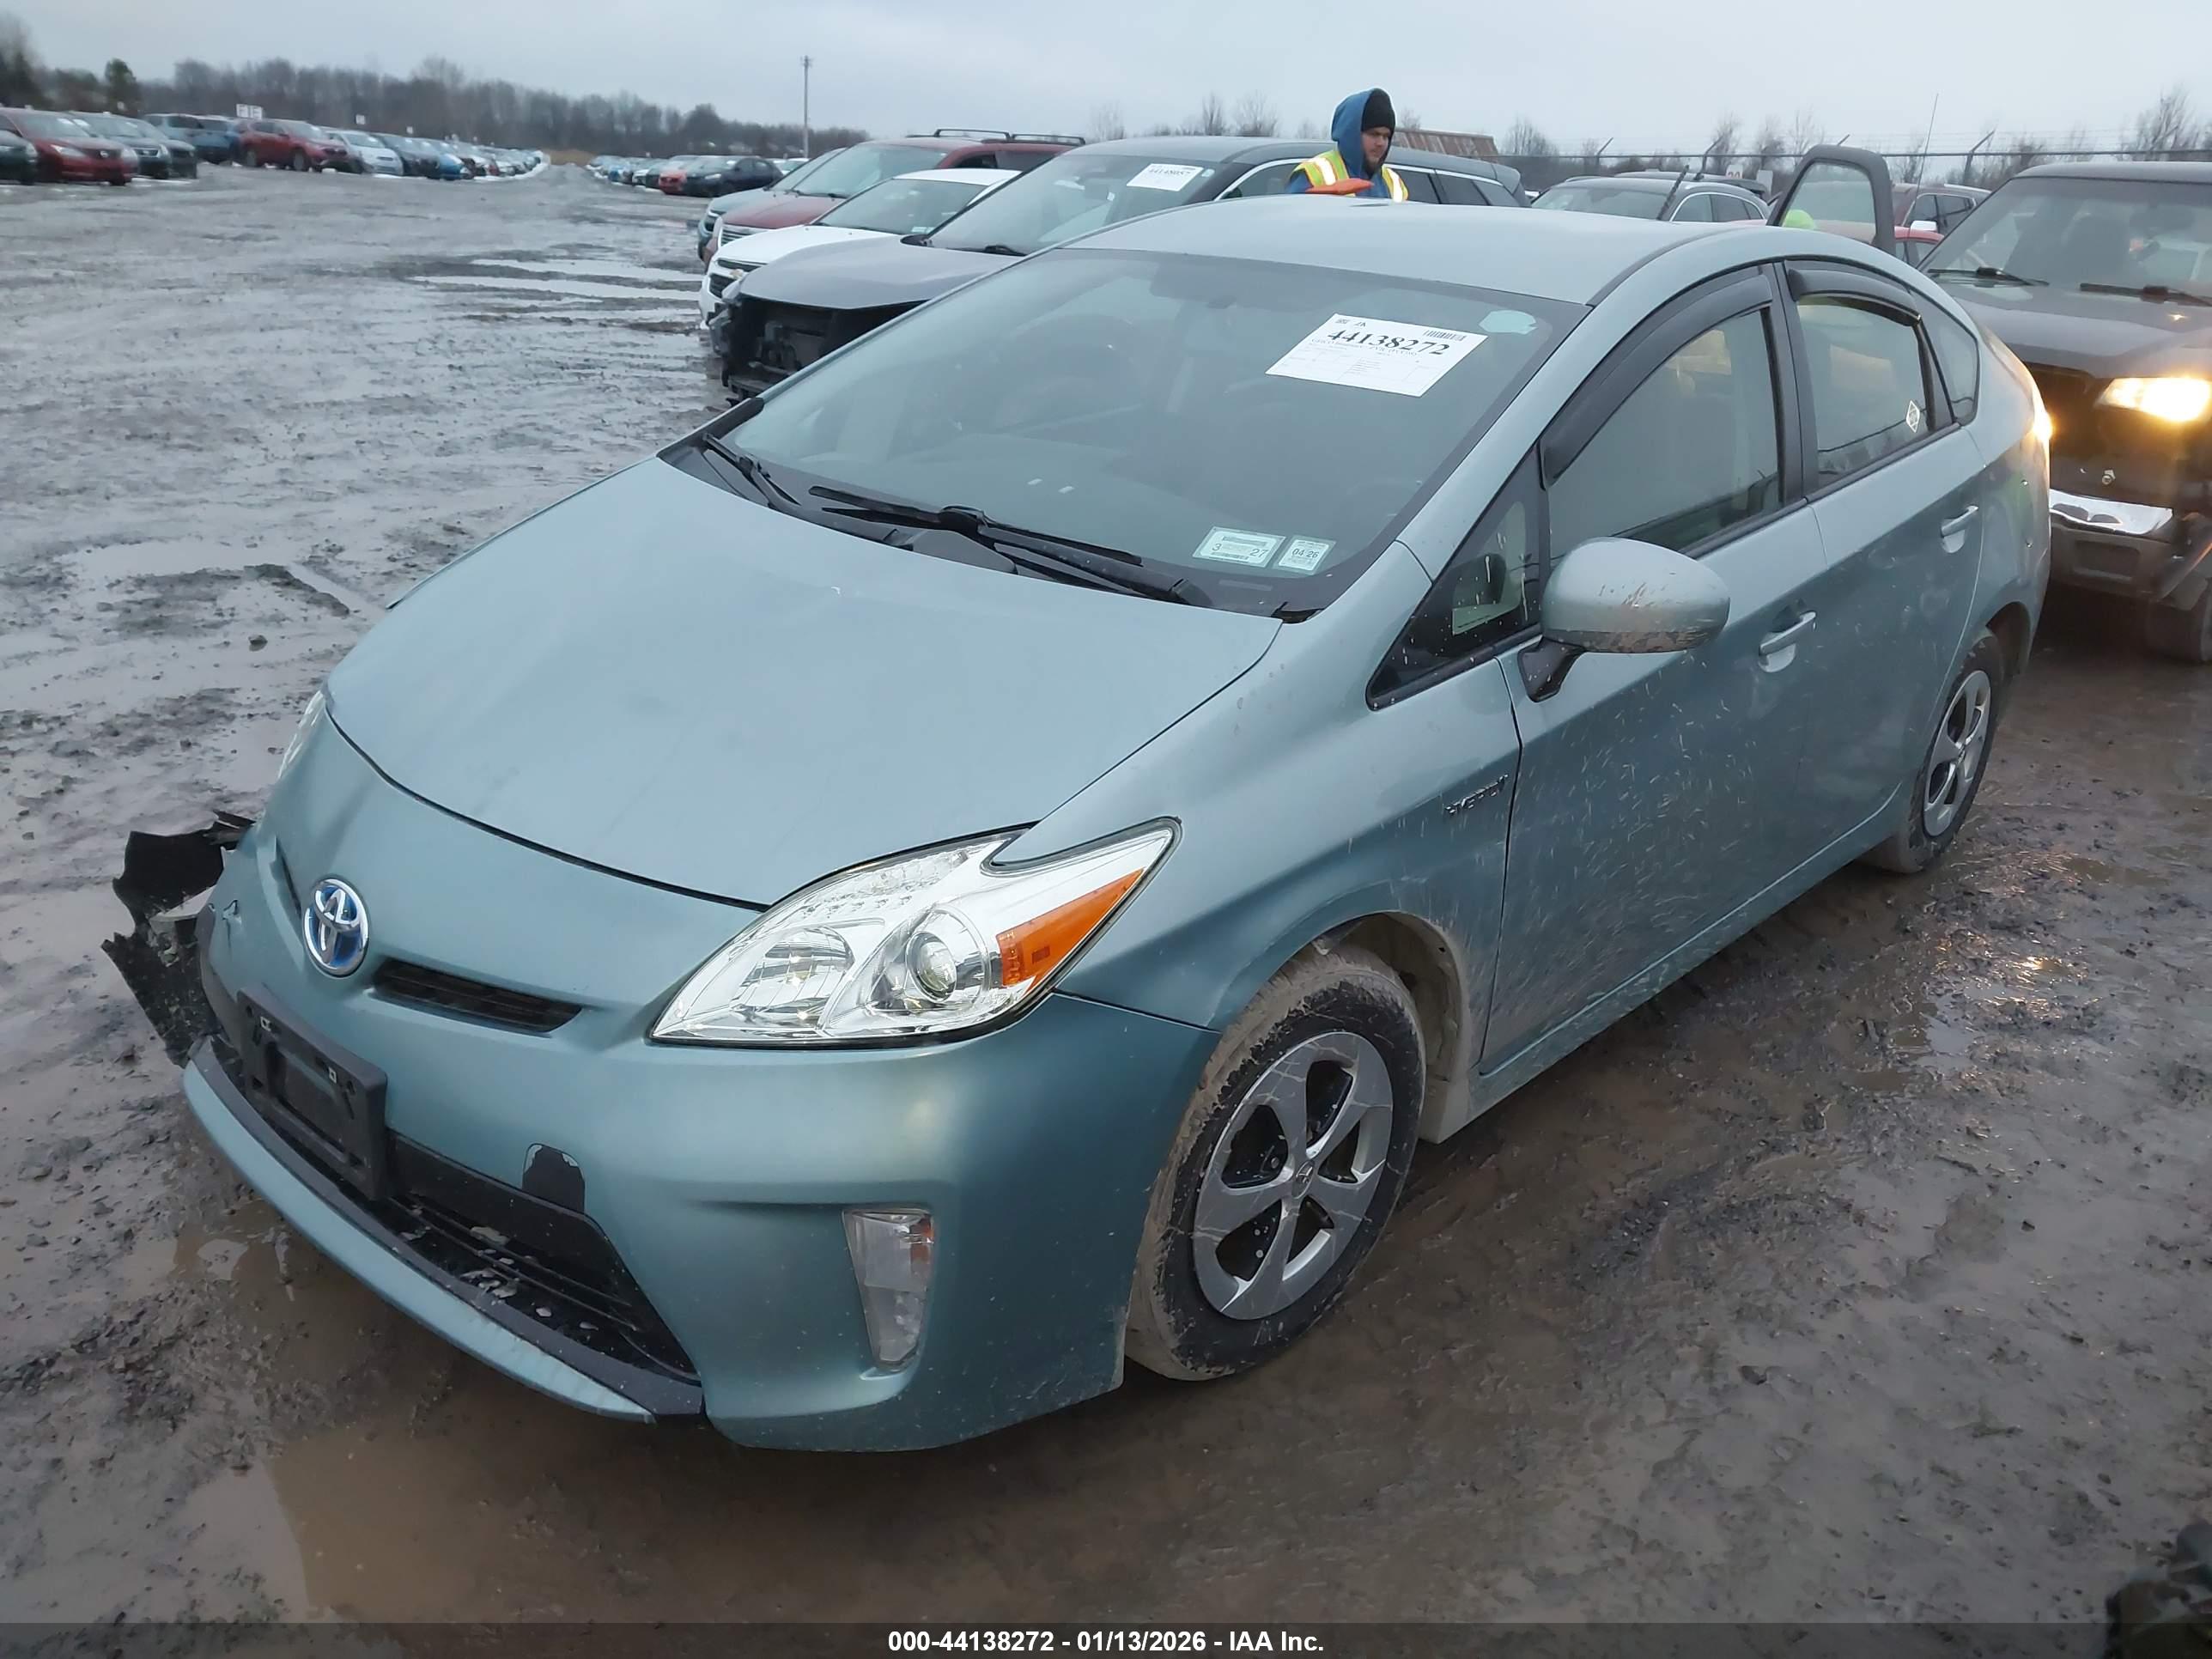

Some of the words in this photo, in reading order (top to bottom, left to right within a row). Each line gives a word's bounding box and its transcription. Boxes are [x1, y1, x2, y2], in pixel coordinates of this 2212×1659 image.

[1328, 329, 1450, 356] 44138272
[1212, 543, 1222, 551] 3
[1249, 548, 1269, 558] 27
